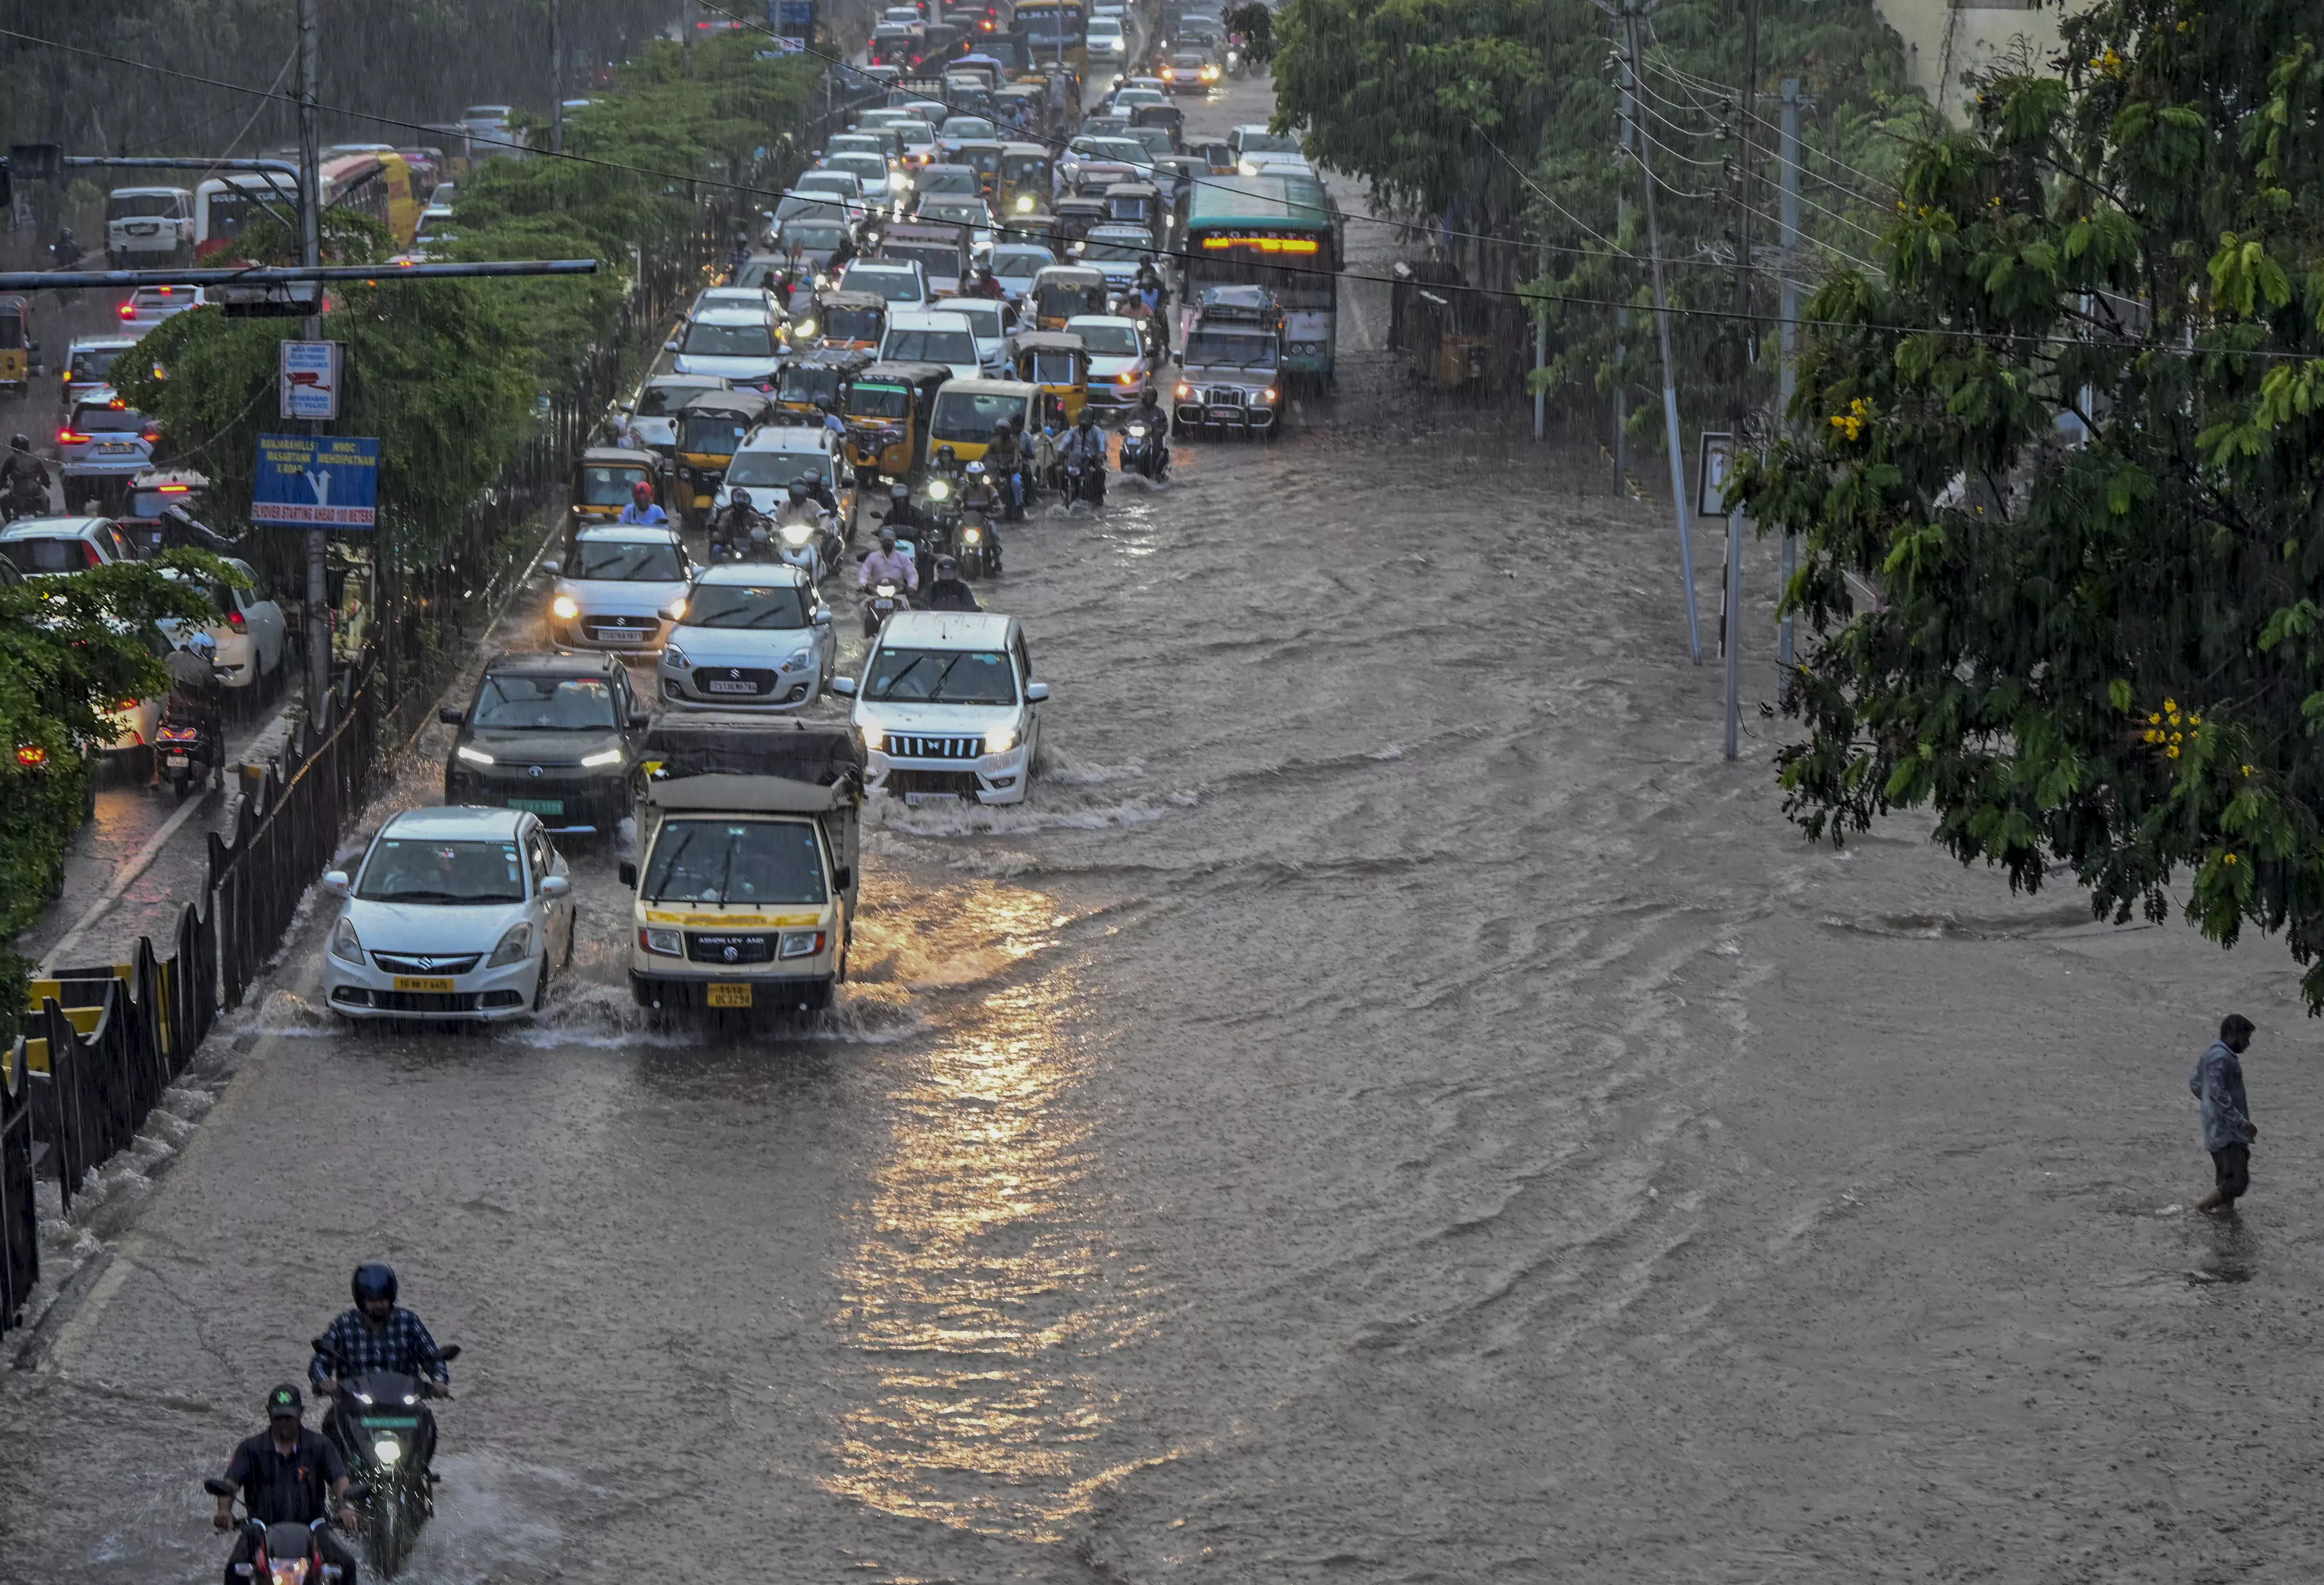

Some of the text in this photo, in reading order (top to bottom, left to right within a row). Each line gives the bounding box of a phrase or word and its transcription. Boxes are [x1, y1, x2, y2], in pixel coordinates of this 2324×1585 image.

[253, 505, 280, 519] FLYOVER
[282, 506, 313, 520] STARTING
[314, 508, 335, 521] AHEAD
[349, 509, 373, 523] METERS
